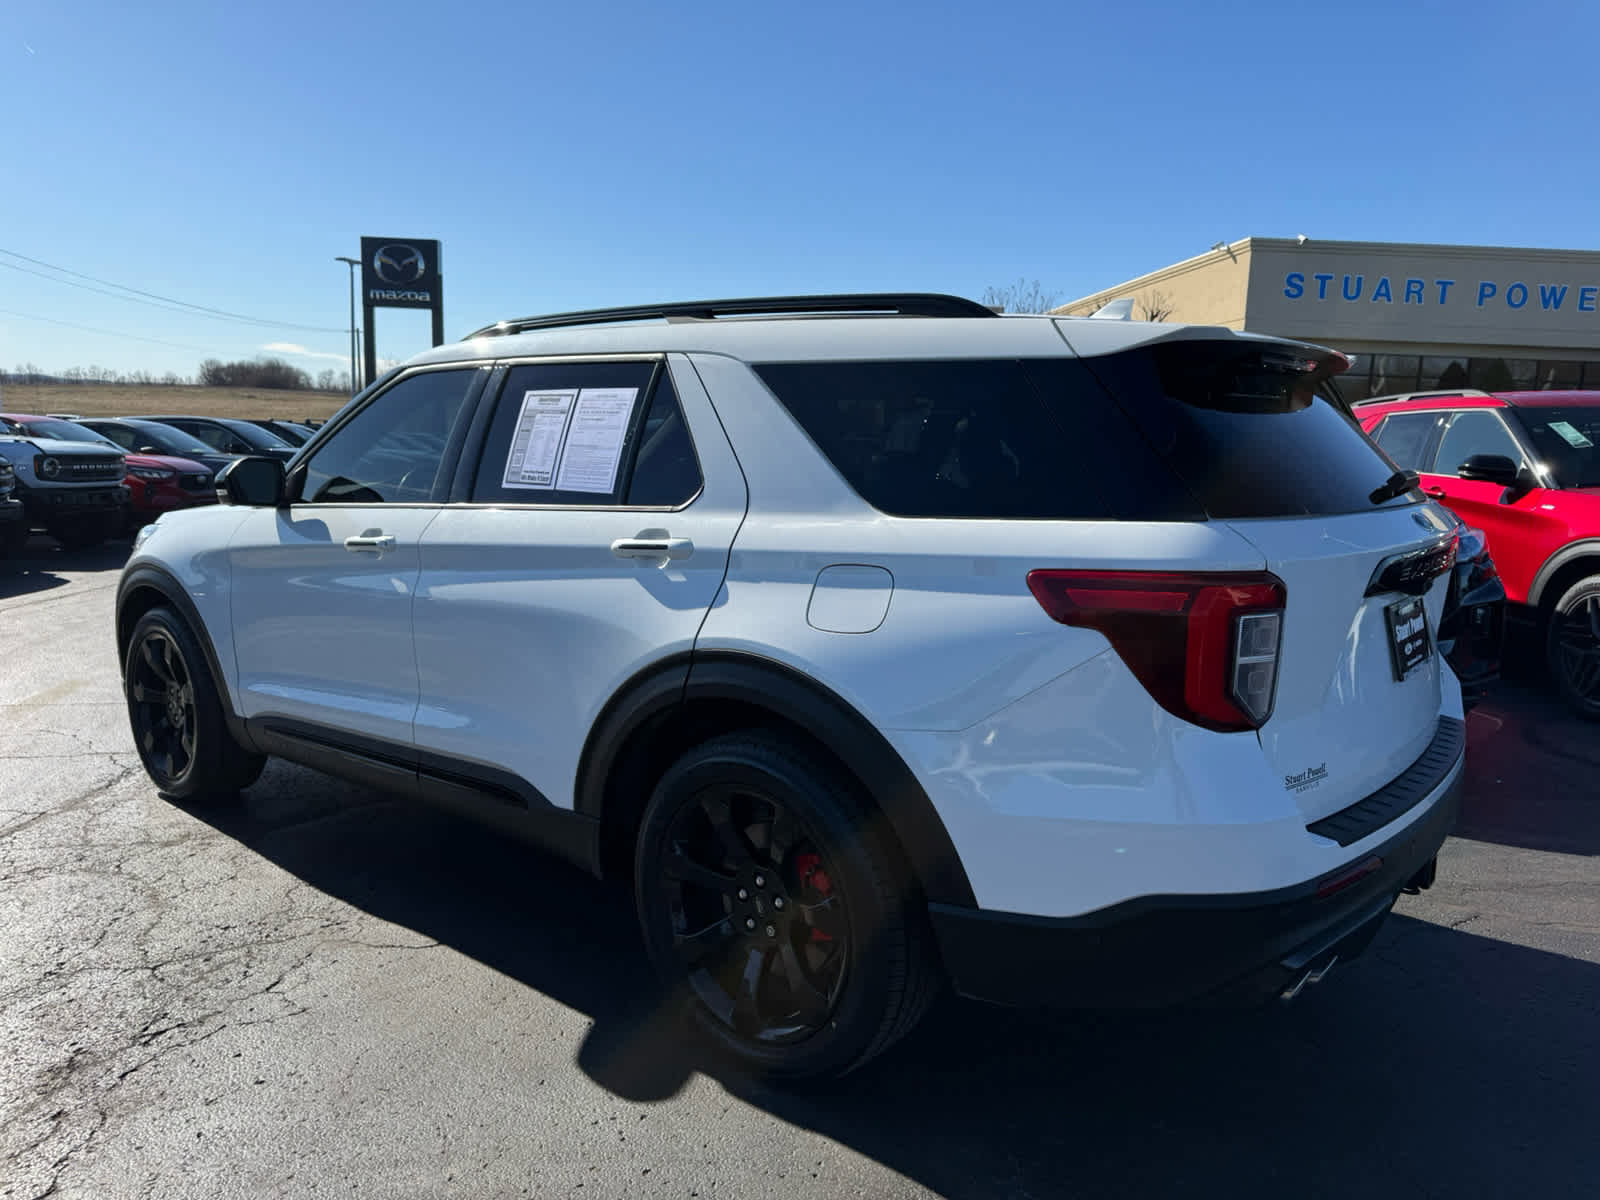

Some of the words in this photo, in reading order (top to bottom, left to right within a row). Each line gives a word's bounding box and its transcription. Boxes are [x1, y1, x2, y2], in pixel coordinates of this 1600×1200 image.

[369, 288, 431, 302] mazda
[1283, 272, 1455, 305] STUART
[1477, 281, 1598, 312] POWE
